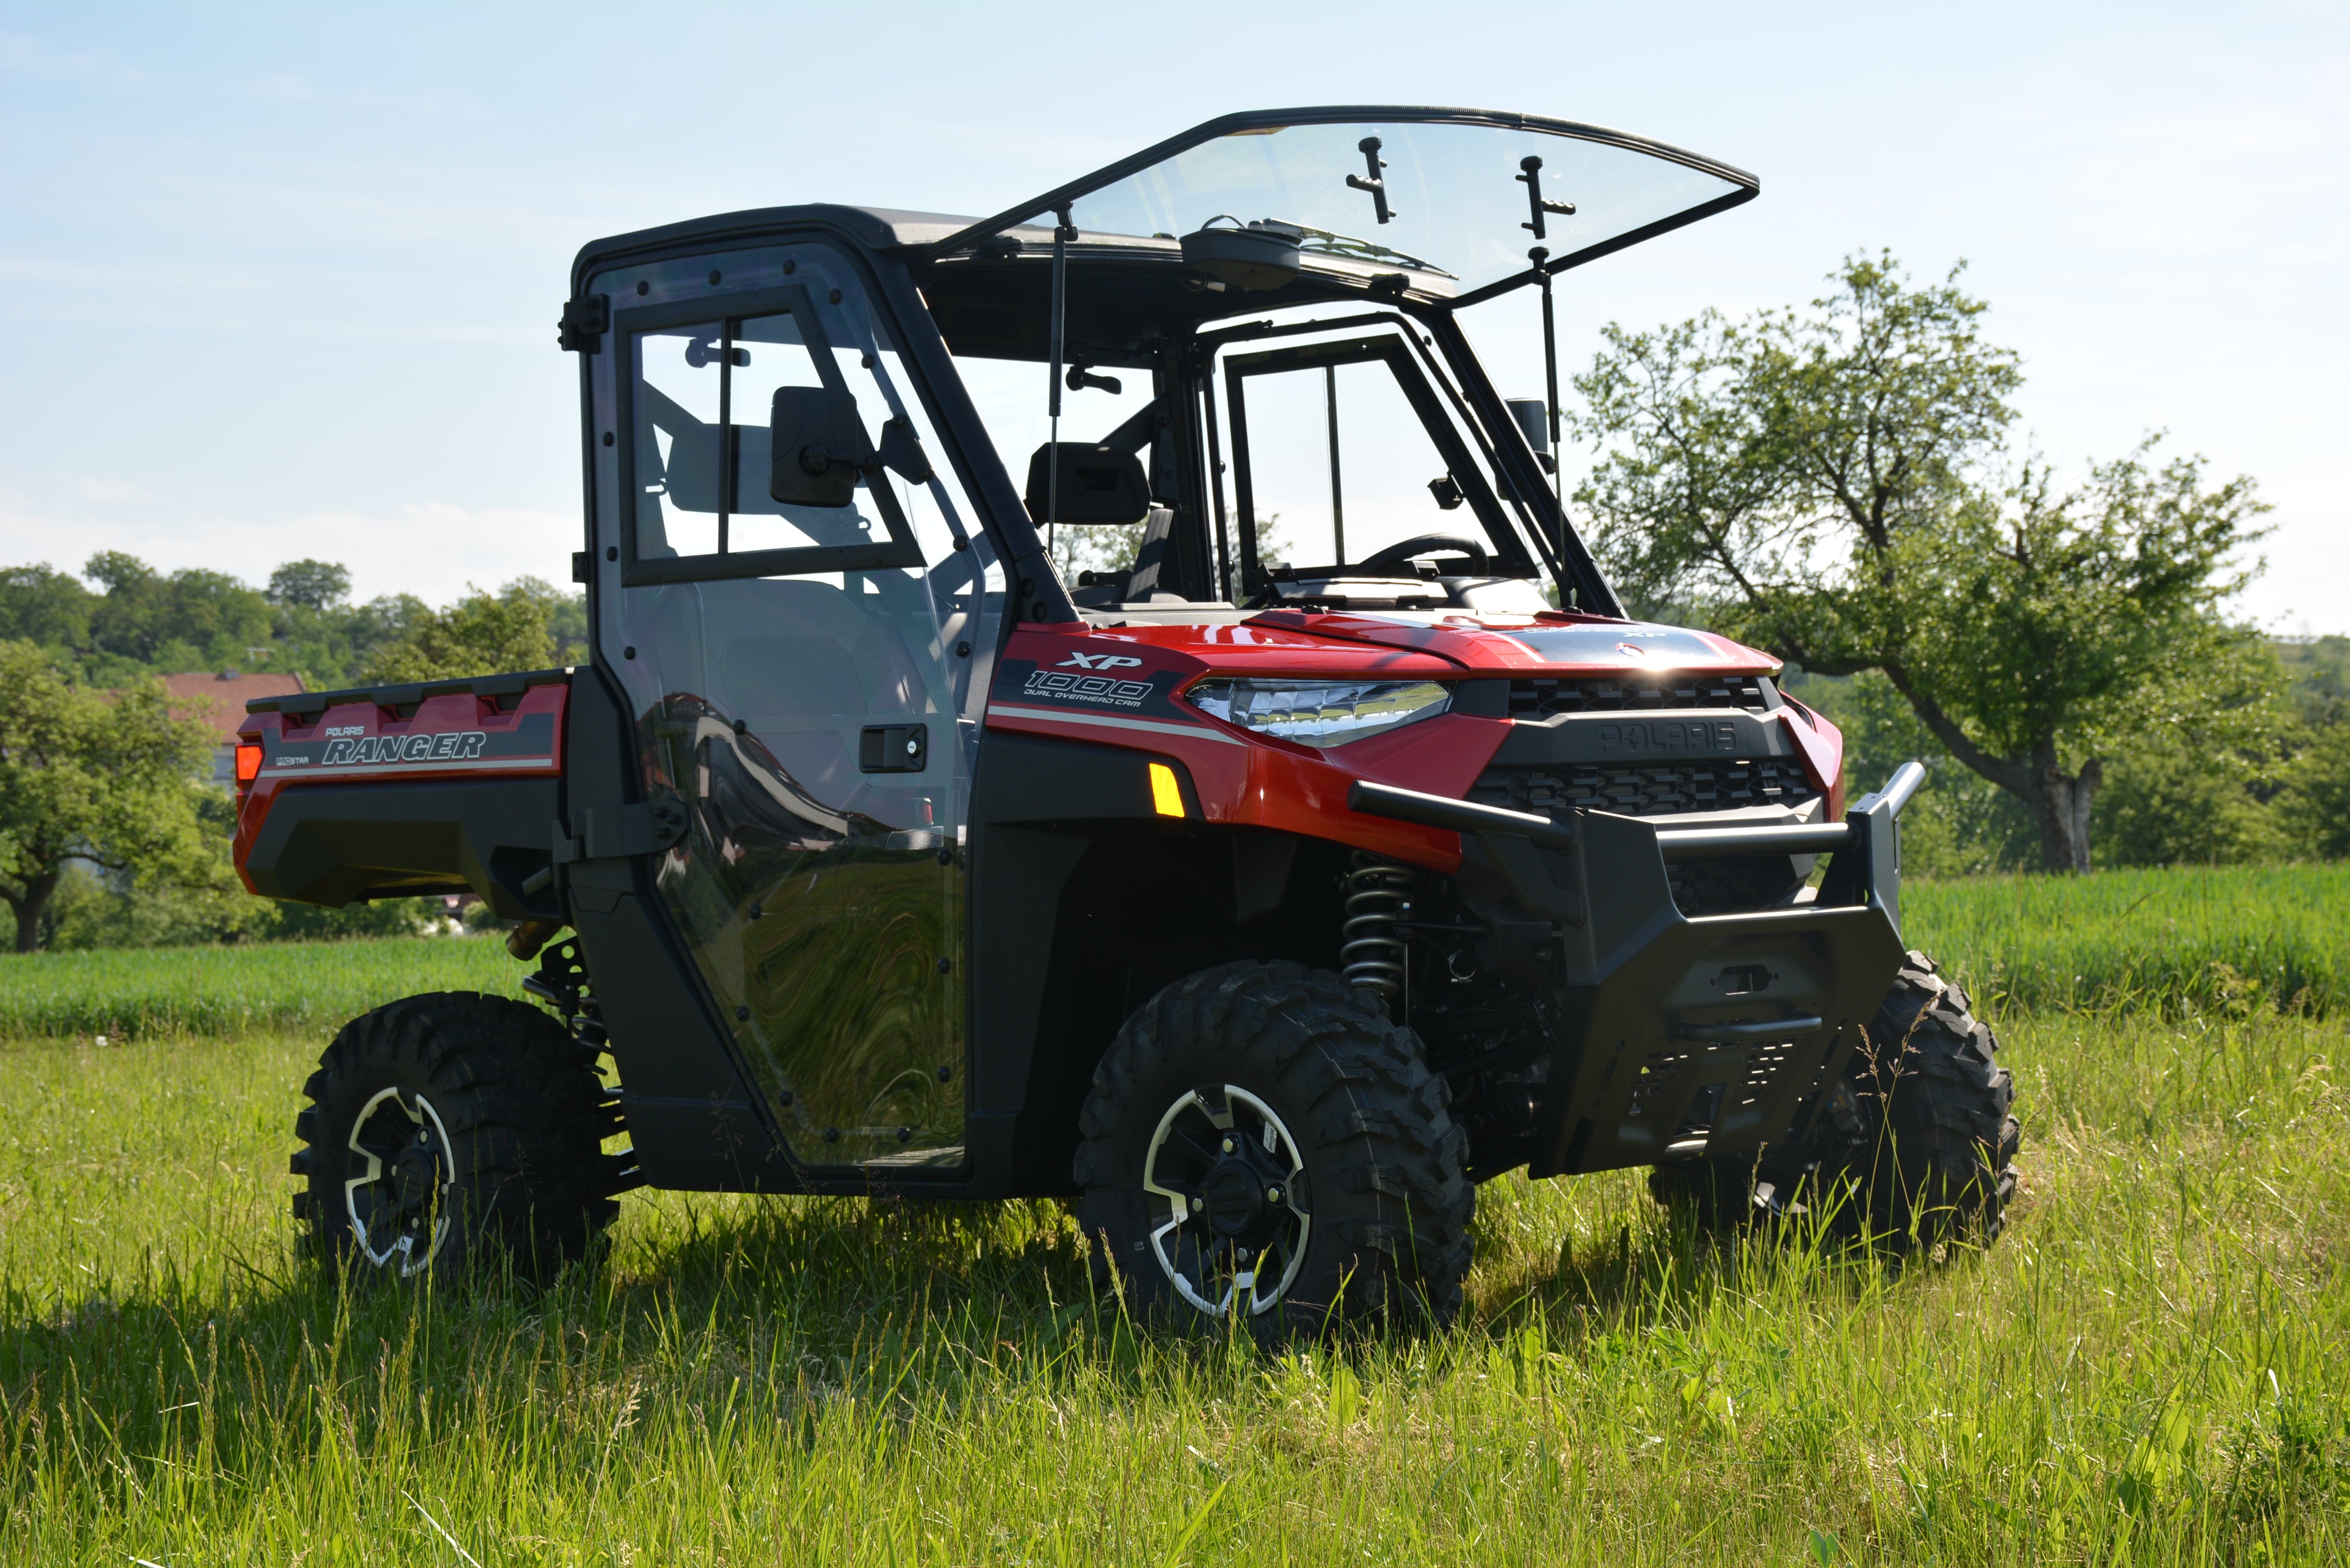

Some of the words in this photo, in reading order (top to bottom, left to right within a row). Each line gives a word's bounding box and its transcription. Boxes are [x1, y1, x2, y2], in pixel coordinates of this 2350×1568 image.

[1054, 651, 1143, 671] XP
[1024, 670, 1154, 700] 1000
[1023, 688, 1052, 697] DUAL
[1054, 692, 1114, 704] OVERHEAD
[1114, 699, 1142, 708] CAM
[325, 725, 365, 737] POLARIS
[1596, 722, 1736, 753] POLARIS
[321, 731, 487, 765] RANGER
[276, 756, 309, 766] PROSTAR
